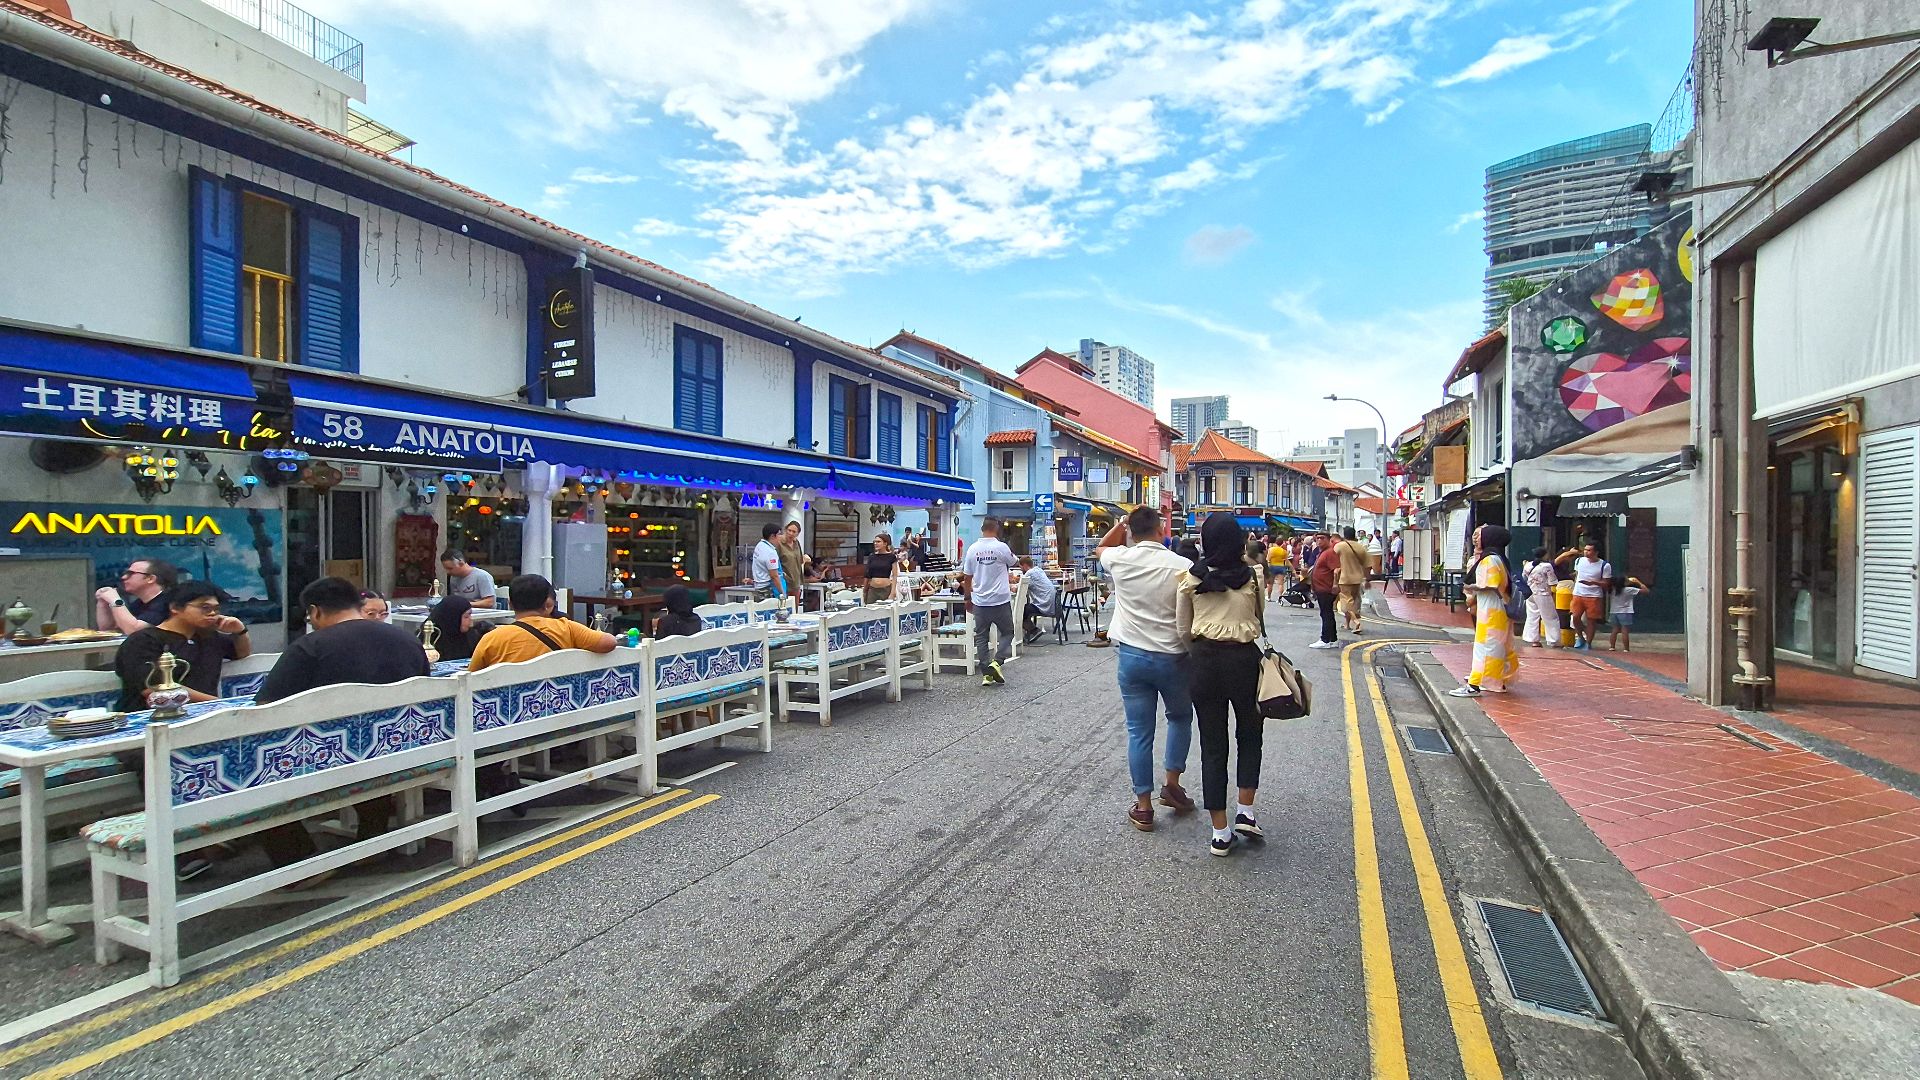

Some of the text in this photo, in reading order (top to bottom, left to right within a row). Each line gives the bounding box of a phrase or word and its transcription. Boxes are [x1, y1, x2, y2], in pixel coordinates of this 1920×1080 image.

[22, 377, 223, 428] 土耳其料理
[322, 413, 364, 440] 58
[395, 422, 535, 458] ANATOLIA
[10, 512, 221, 535] ANATOLIA
[1516, 507, 1537, 523] 12
